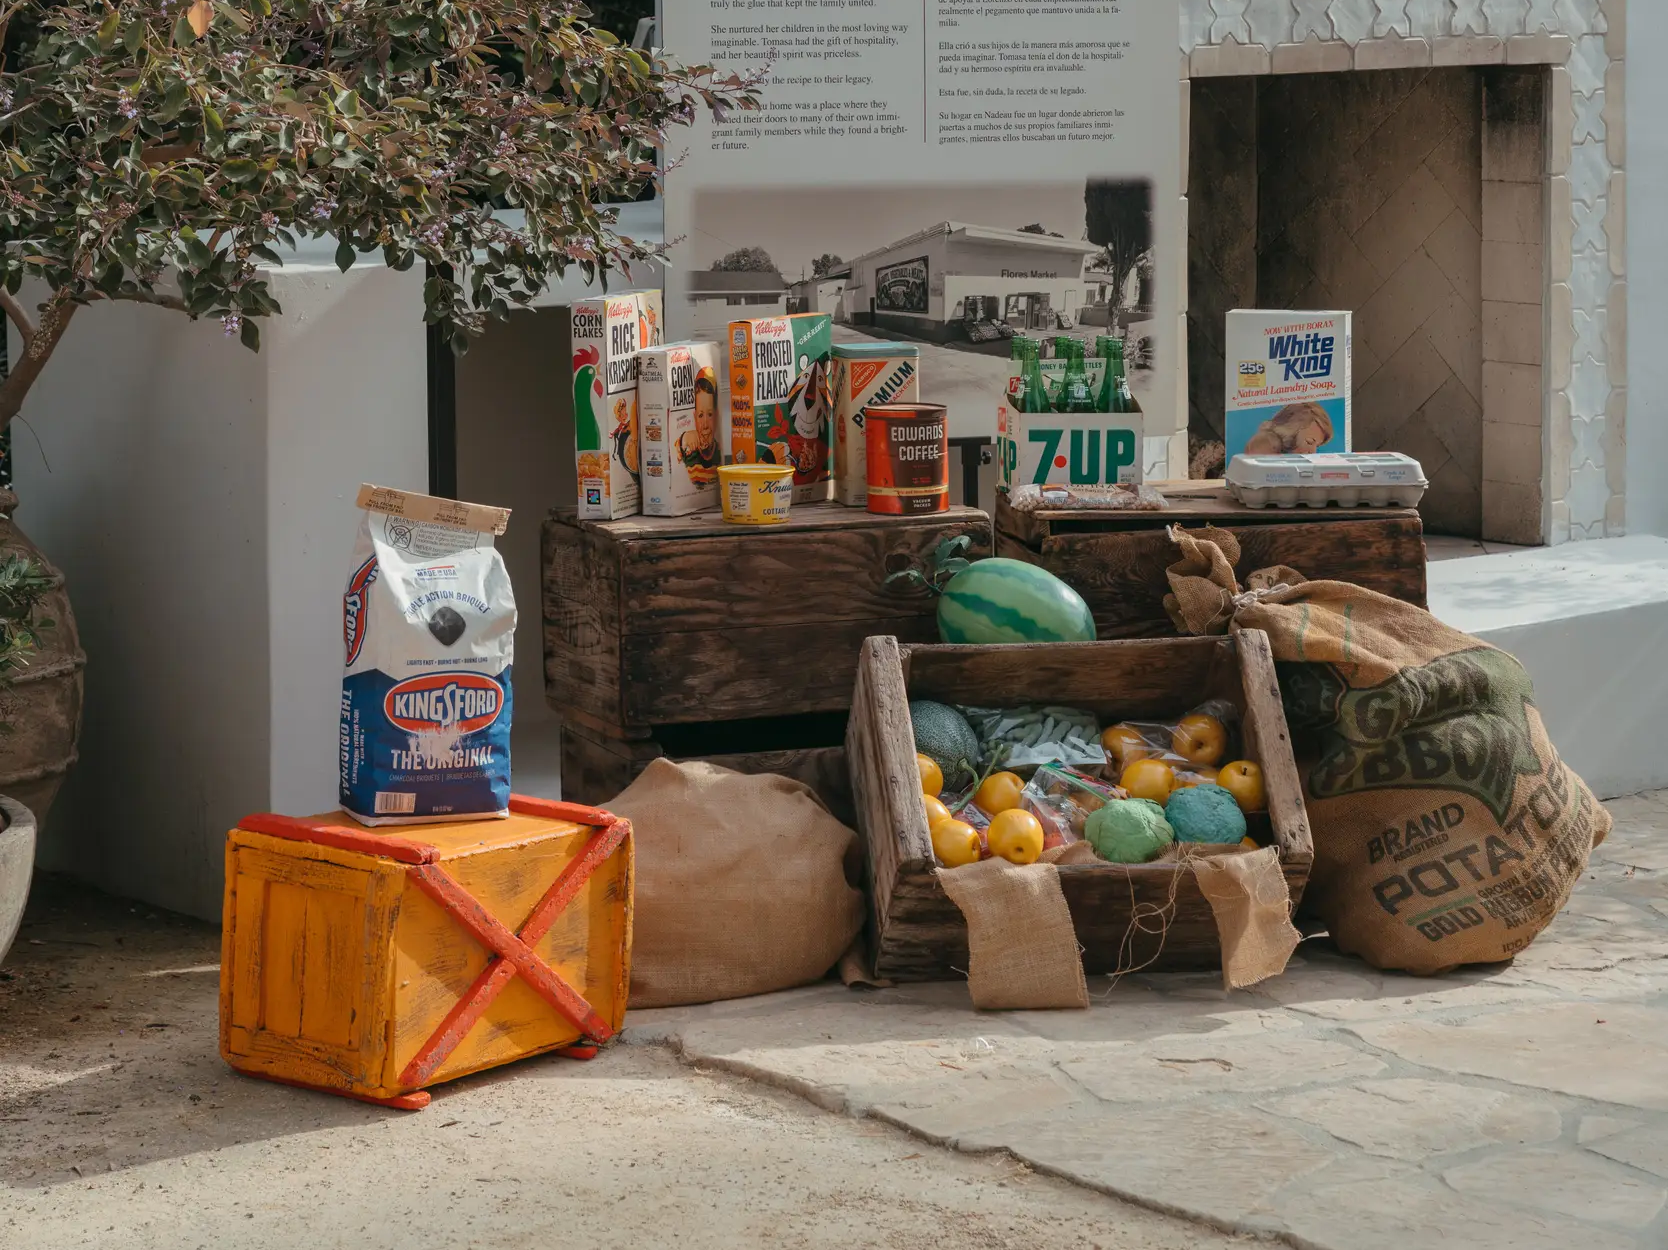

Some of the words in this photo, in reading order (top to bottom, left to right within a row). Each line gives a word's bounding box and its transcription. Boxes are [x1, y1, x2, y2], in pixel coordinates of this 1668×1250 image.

[710, 24, 726, 33] She
[728, 24, 764, 33] nurtured
[765, 24, 779, 33] her
[780, 24, 814, 33] children
[816, 24, 825, 32] in
[826, 24, 839, 32] the
[841, 23, 862, 32] most
[862, 23, 889, 34] loving
[891, 26, 908, 34] way
[969, 133, 1000, 142] mientras
[1002, 133, 1020, 142] ellos
[1021, 132, 1055, 141] buscaban
[1068, 132, 1090, 141] futuro
[1001, 268, 1028, 279] Flores
[1030, 269, 1057, 279] Market
[572, 314, 603, 328] CORN
[1263, 326, 1283, 336] NOW
[1283, 323, 1305, 334] WITH
[1306, 320, 1334, 331] BORAX
[573, 327, 604, 339] FLAKES
[612, 322, 635, 356] RICE
[755, 339, 792, 369] FROSTED
[1269, 332, 1334, 360] White
[671, 364, 693, 389] CORN
[854, 365, 874, 386] NABISCO
[1278, 354, 1333, 381] King
[756, 369, 788, 402] FLAKES
[1232, 385, 1269, 401] Natural
[1270, 381, 1308, 396] Laundry
[1309, 380, 1336, 391] Soap
[672, 388, 695, 407] FLAKES
[890, 424, 943, 443] EDWARDS
[898, 444, 939, 461] COFFEE
[393, 516, 420, 526] WARNING
[416, 569, 436, 577] MADE
[426, 590, 454, 602] ACTION
[456, 592, 491, 614] BRIQUET
[341, 689, 352, 721] THE
[393, 682, 497, 727] KINGSFORD
[391, 749, 422, 770] THE
[1367, 802, 1465, 866] BRAND
[1393, 832, 1450, 864] REGISTERED
[1478, 875, 1520, 898] GROWN
[1418, 905, 1484, 943] GOLD
